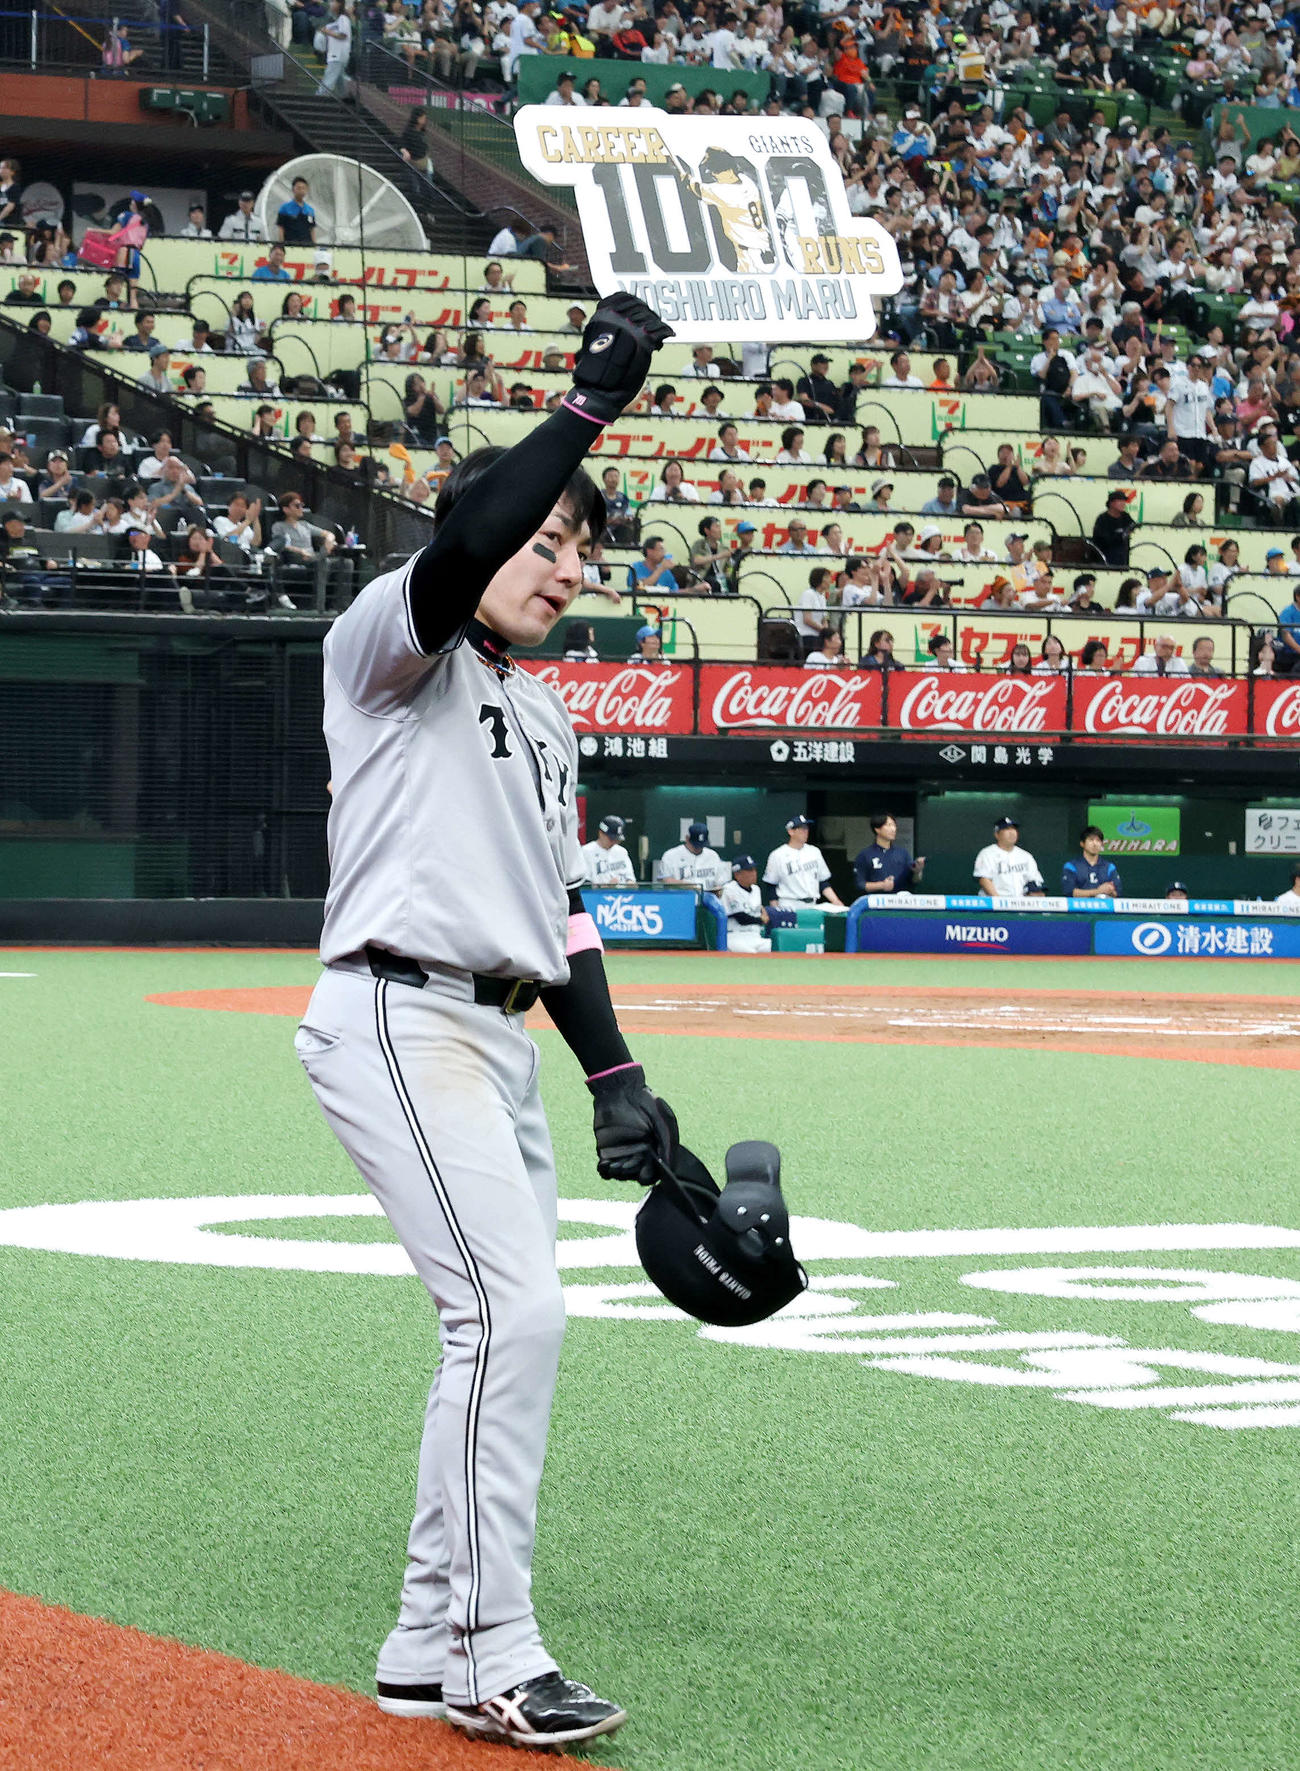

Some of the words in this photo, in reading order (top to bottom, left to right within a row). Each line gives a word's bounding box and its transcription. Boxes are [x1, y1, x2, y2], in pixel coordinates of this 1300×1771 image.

[536, 125, 669, 163] CAREER
[749, 135, 814, 154] GIANTS
[797, 237, 885, 275] RUNS
[773, 279, 858, 320] MARU
[712, 671, 871, 727] Coca-Cola
[900, 676, 1055, 731] Coca-Cola
[1085, 680, 1237, 735] Coca-Cola
[604, 736, 668, 759] 鴻池組
[793, 741, 855, 763] 五洋建設
[945, 925, 1009, 942] MIZUHO
[1176, 924, 1274, 955] 清水建設
